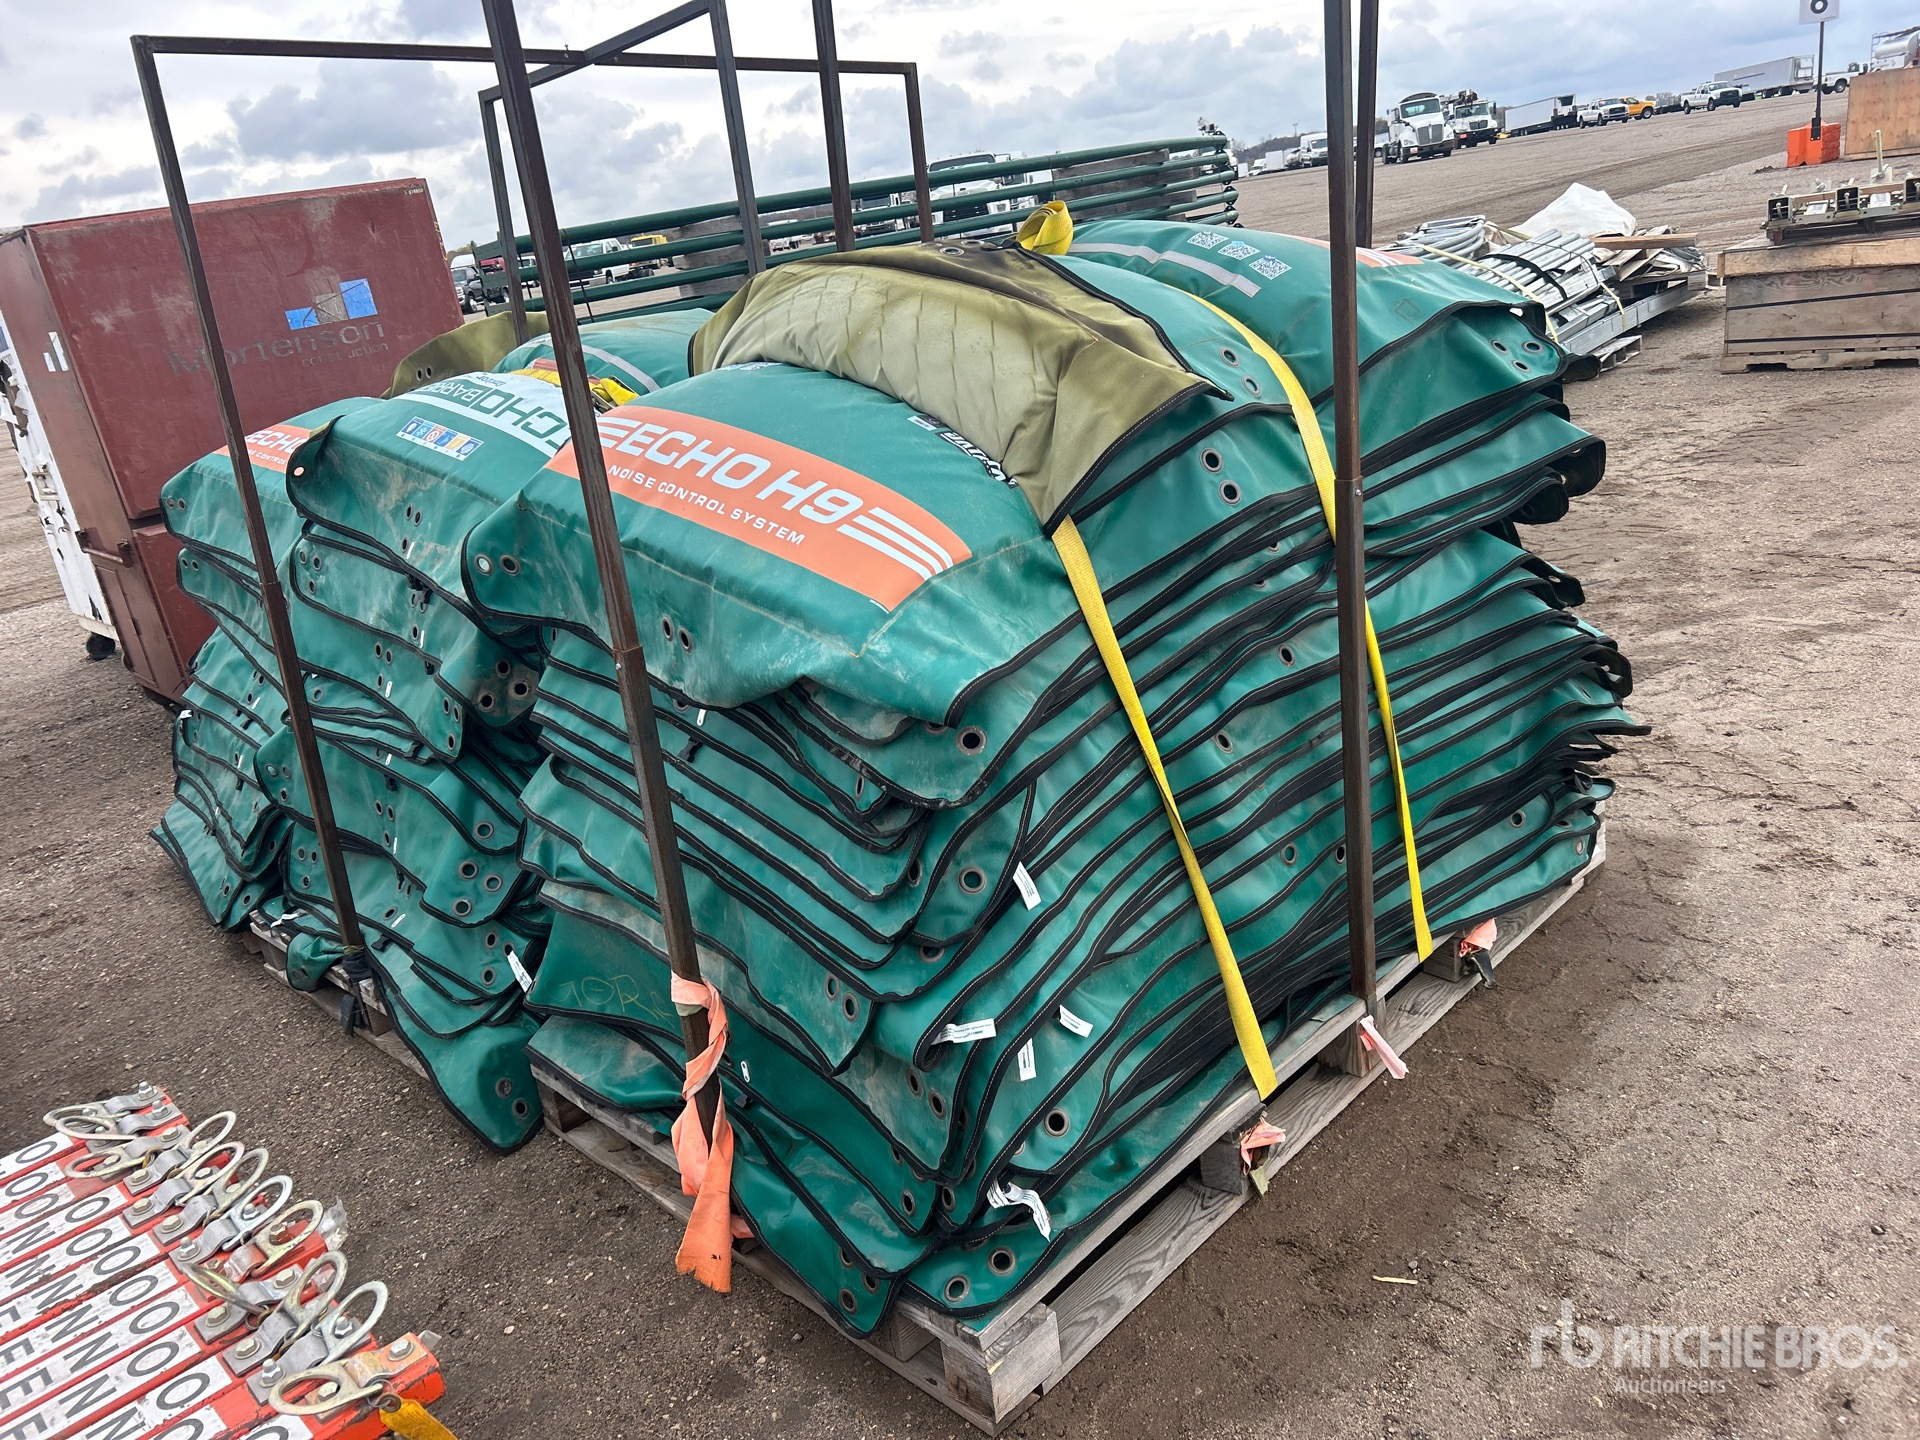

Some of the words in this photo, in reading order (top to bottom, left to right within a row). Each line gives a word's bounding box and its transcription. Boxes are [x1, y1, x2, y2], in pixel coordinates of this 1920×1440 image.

[302, 340, 389, 368] costuction
[470, 388, 568, 449] CHO
[608, 464, 656, 489] NOISE
[657, 481, 726, 515] CONTROL
[730, 508, 806, 545] SYSTEM
[615, 422, 772, 490] ECHO
[755, 469, 864, 525] H9
